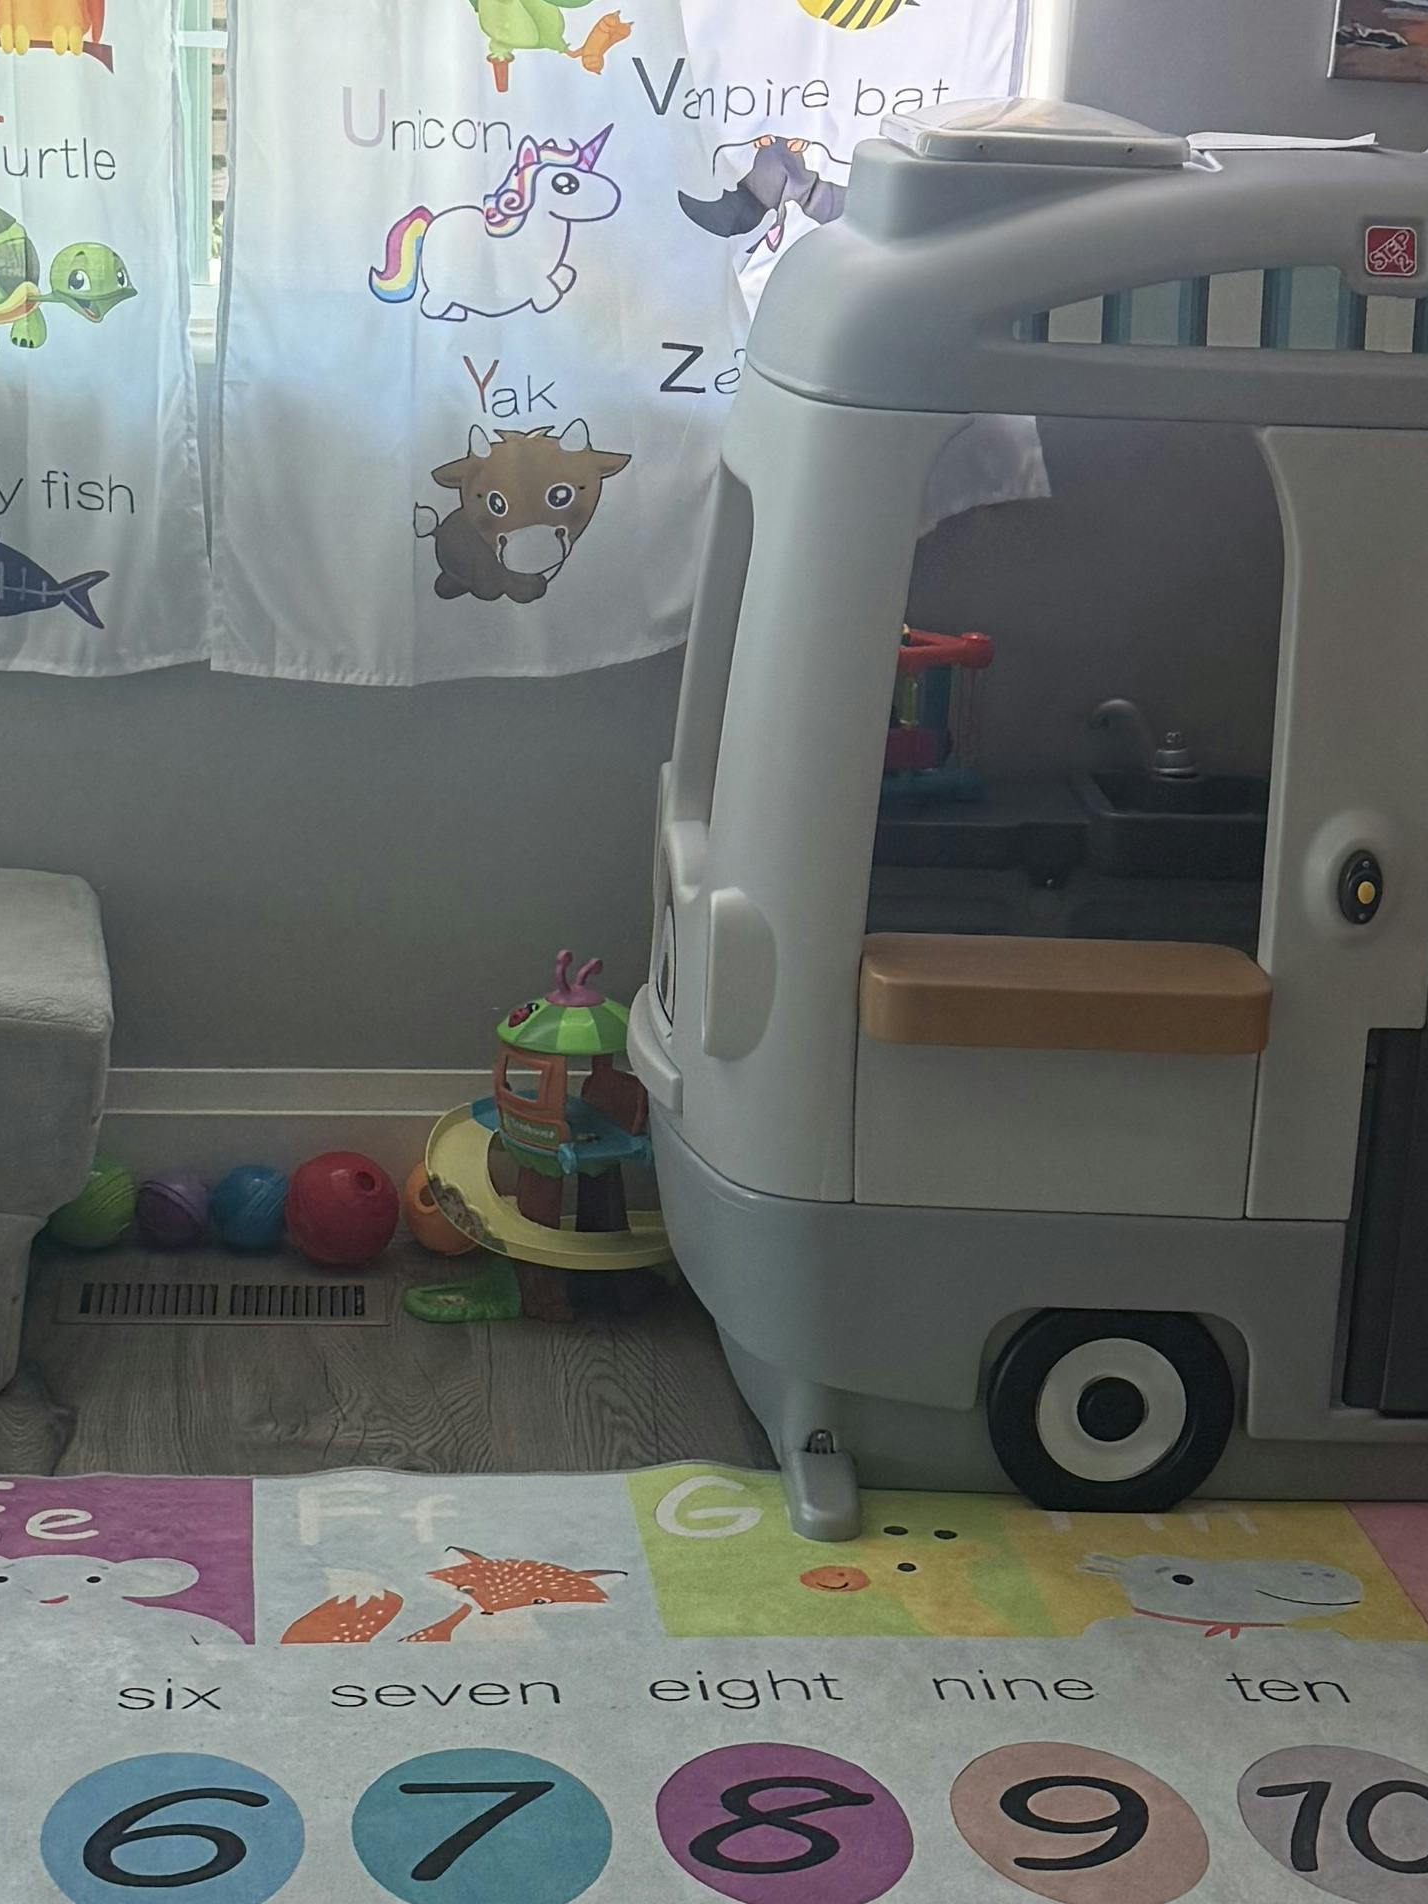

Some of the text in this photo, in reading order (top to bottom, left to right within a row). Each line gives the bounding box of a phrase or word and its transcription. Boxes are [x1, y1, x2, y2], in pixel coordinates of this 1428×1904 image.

[343, 86, 511, 153] Unicon
[854, 78, 949, 117] bat
[463, 355, 557, 420] Yak
[41, 469, 136, 515] fish
[297, 1480, 461, 1545] Ff
[655, 1474, 764, 1541] G
[116, 1676, 222, 1711] six
[329, 1676, 562, 1709] seven
[648, 1669, 846, 1711] eight
[929, 1667, 1099, 1704] nine
[1226, 1669, 1353, 1706] ten
[81, 1786, 270, 1889] 6
[398, 1781, 556, 1882] 7
[687, 1775, 876, 1874] 8
[998, 1774, 1150, 1871] 9
